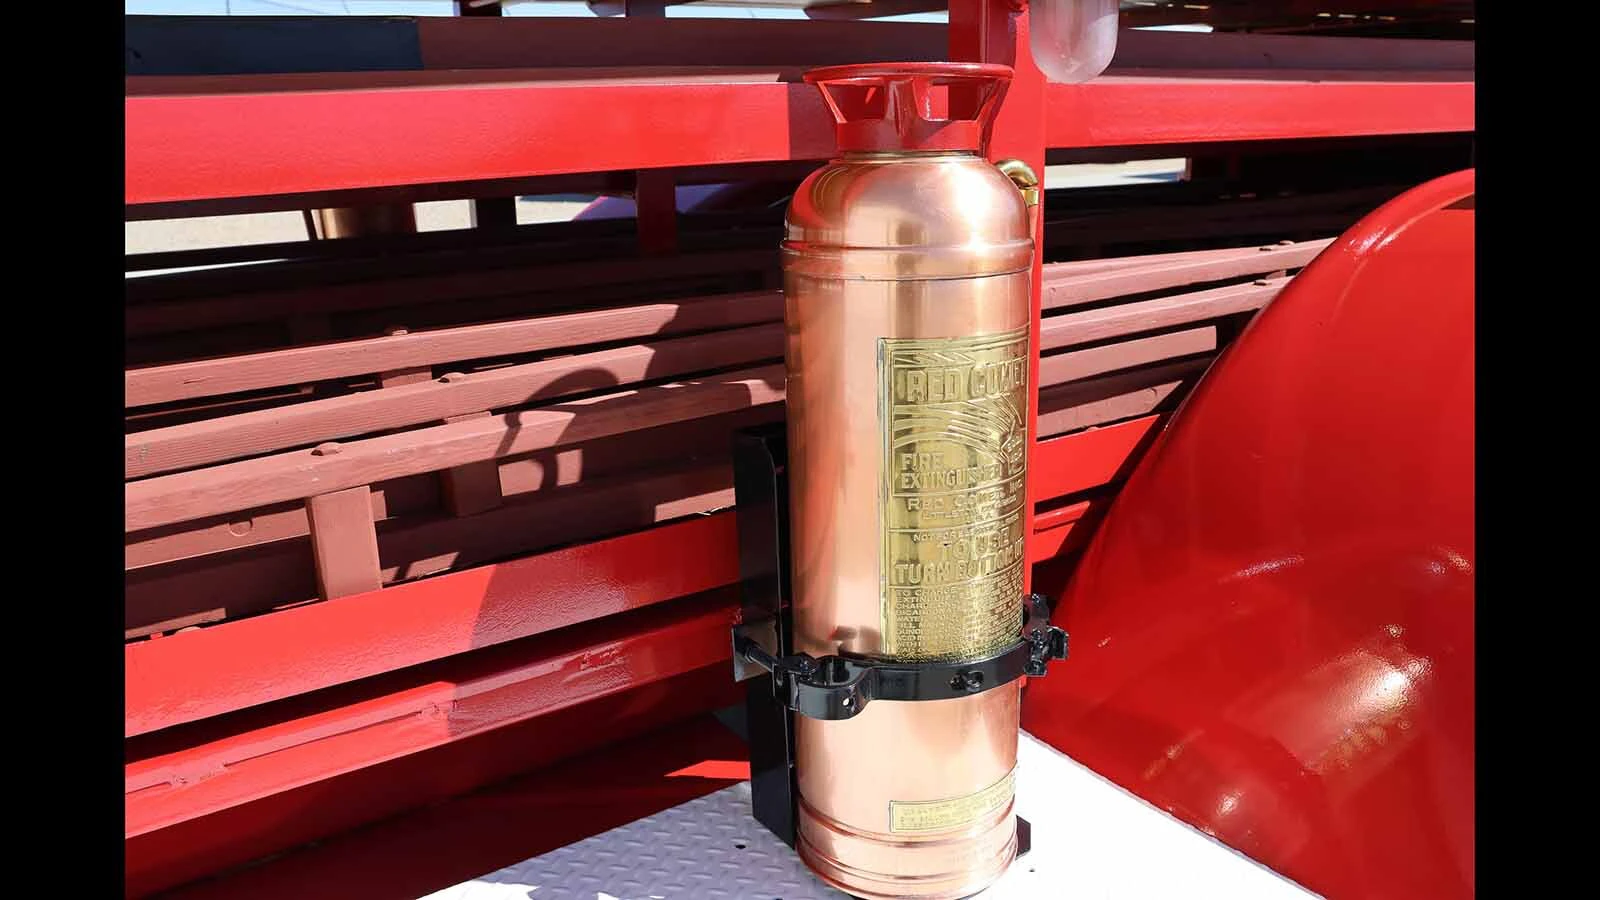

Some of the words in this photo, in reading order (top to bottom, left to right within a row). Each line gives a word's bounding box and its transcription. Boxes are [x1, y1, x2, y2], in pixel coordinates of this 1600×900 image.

[906, 368, 963, 402] RED
[901, 453, 945, 472] FIRE
[895, 562, 952, 584] TURN
